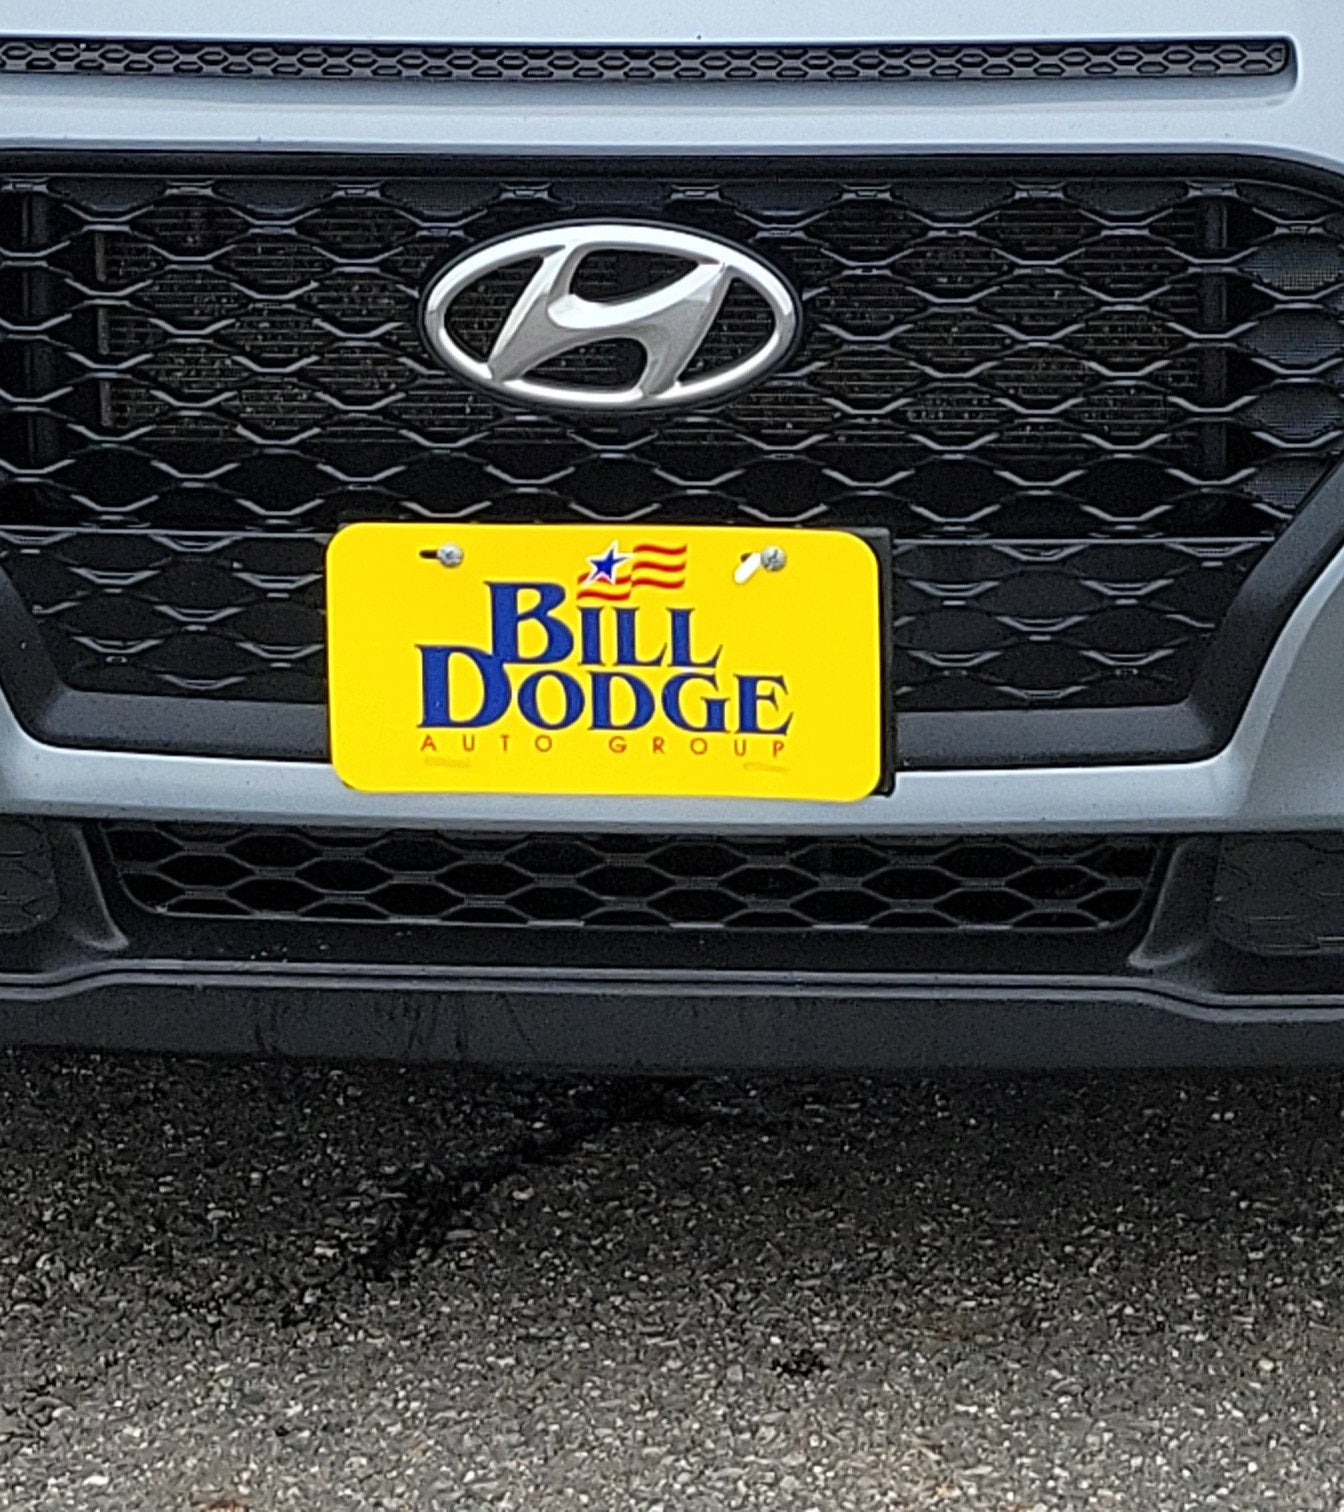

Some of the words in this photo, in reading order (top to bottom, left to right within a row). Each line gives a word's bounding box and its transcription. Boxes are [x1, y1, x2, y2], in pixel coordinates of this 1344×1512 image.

[484, 581, 723, 668] BILL
[415, 644, 794, 735] DODGE
[420, 733, 553, 753] AUTO
[608, 735, 787, 758] GROUP
